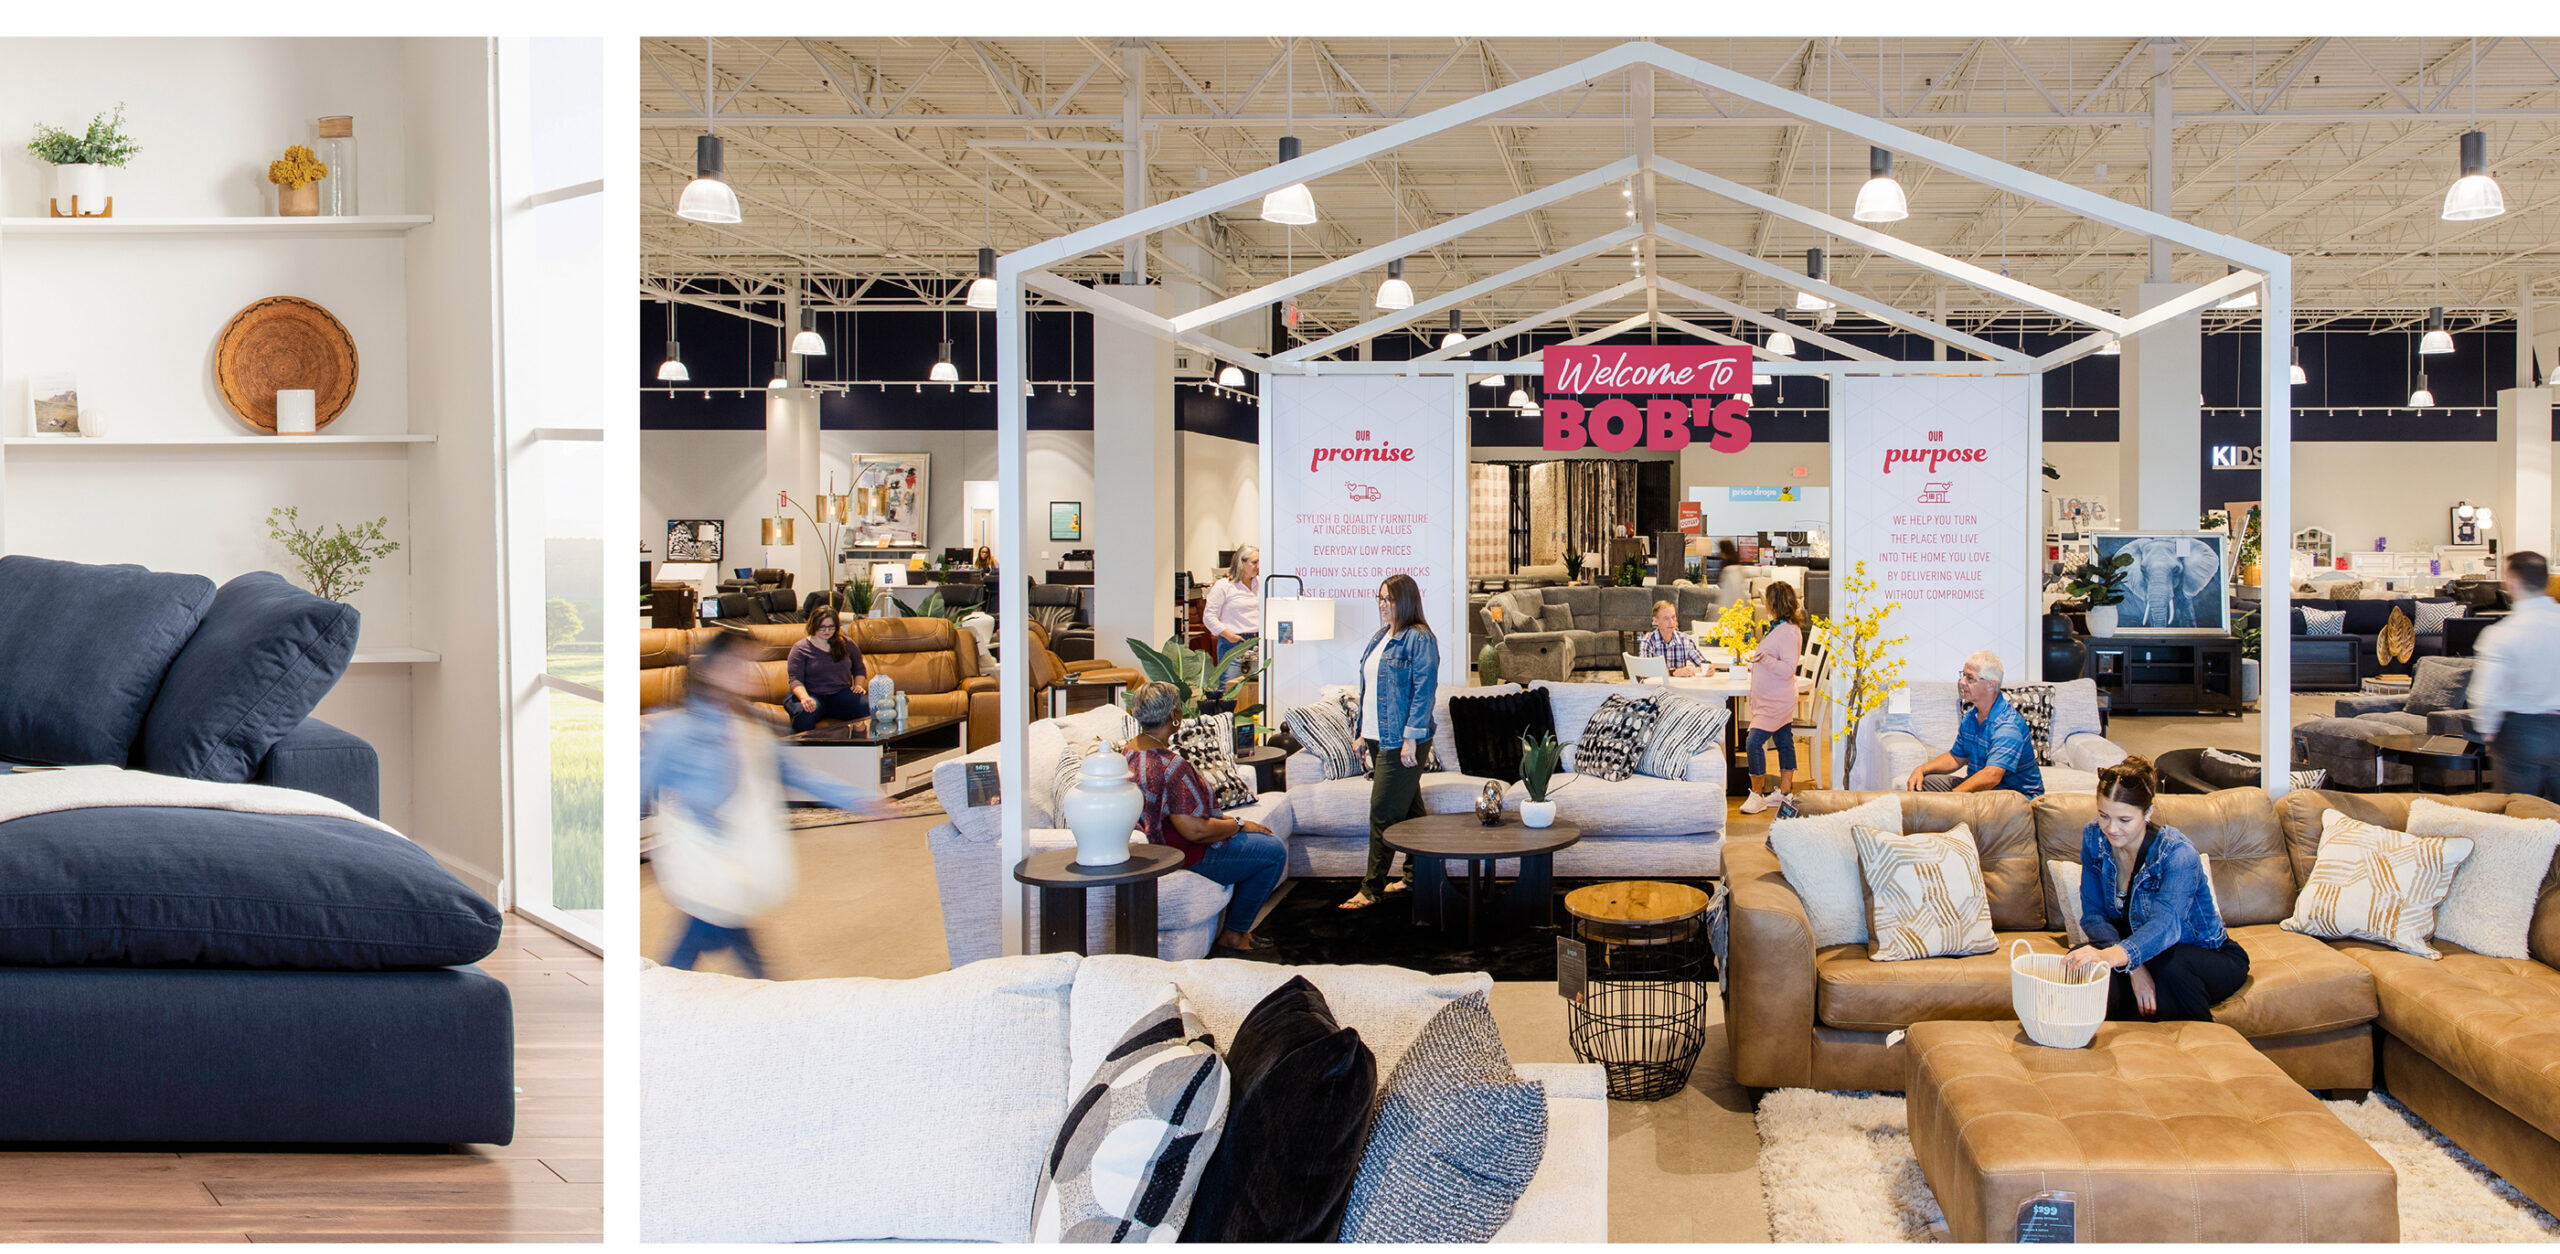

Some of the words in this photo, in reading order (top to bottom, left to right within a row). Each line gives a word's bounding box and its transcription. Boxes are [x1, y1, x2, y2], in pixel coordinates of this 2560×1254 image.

[1557, 352, 1695, 395] Welcome
[1697, 358, 1737, 391] To
[1542, 398, 1753, 454] BOB'S
[1355, 430, 1370, 441] OUR
[1928, 431, 1944, 442] OUR
[1310, 441, 1416, 472] promise
[1882, 448, 1989, 474] purpose
[2212, 445, 2262, 466] KIDS
[1732, 487, 1752, 497] price
[1753, 486, 1777, 497] drops
[1296, 514, 1331, 524] STYLISH
[1333, 514, 1340, 524] &
[1343, 514, 1378, 524] QUALITY
[1380, 514, 1428, 524] FURNITURE
[1680, 518, 1698, 527] OUTLET
[1892, 515, 1907, 525] WE
[1909, 515, 1932, 525] HELP
[1935, 515, 1951, 526] YOU
[1954, 515, 1977, 525] TURN
[1313, 525, 1324, 535] AT
[1326, 525, 1377, 535] INCREDIBLE
[1378, 525, 1412, 535] VALUES
[1891, 534, 1908, 544] THE
[1910, 534, 1937, 544] PLACE
[1940, 534, 1957, 544] YOU
[1960, 534, 1979, 544] LIVE
[1313, 545, 1358, 556] EVERYDAY
[1360, 545, 1379, 556] LOW
[1381, 545, 1412, 556] PRICES
[1879, 552, 1899, 562] INTO
[1901, 552, 1918, 562] THE
[1920, 552, 1946, 562] HOME
[1949, 552, 1966, 562] YOU
[1968, 552, 1991, 562] LOVE
[1295, 567, 1307, 577] NO
[1310, 567, 1339, 577] PHONY
[1341, 567, 1368, 577] SALES
[1371, 567, 1383, 577] OR
[1385, 567, 1431, 577] GIMMICKS
[1887, 571, 1898, 581] BY
[1901, 571, 1952, 581] DELIVERING
[1954, 571, 1982, 581] VALUE
[1319, 588, 1325, 598] &
[1328, 588, 1377, 598] CONVENIEN
[1885, 589, 1924, 600] WITHOUT
[1926, 589, 1985, 600] COMPROMISE
